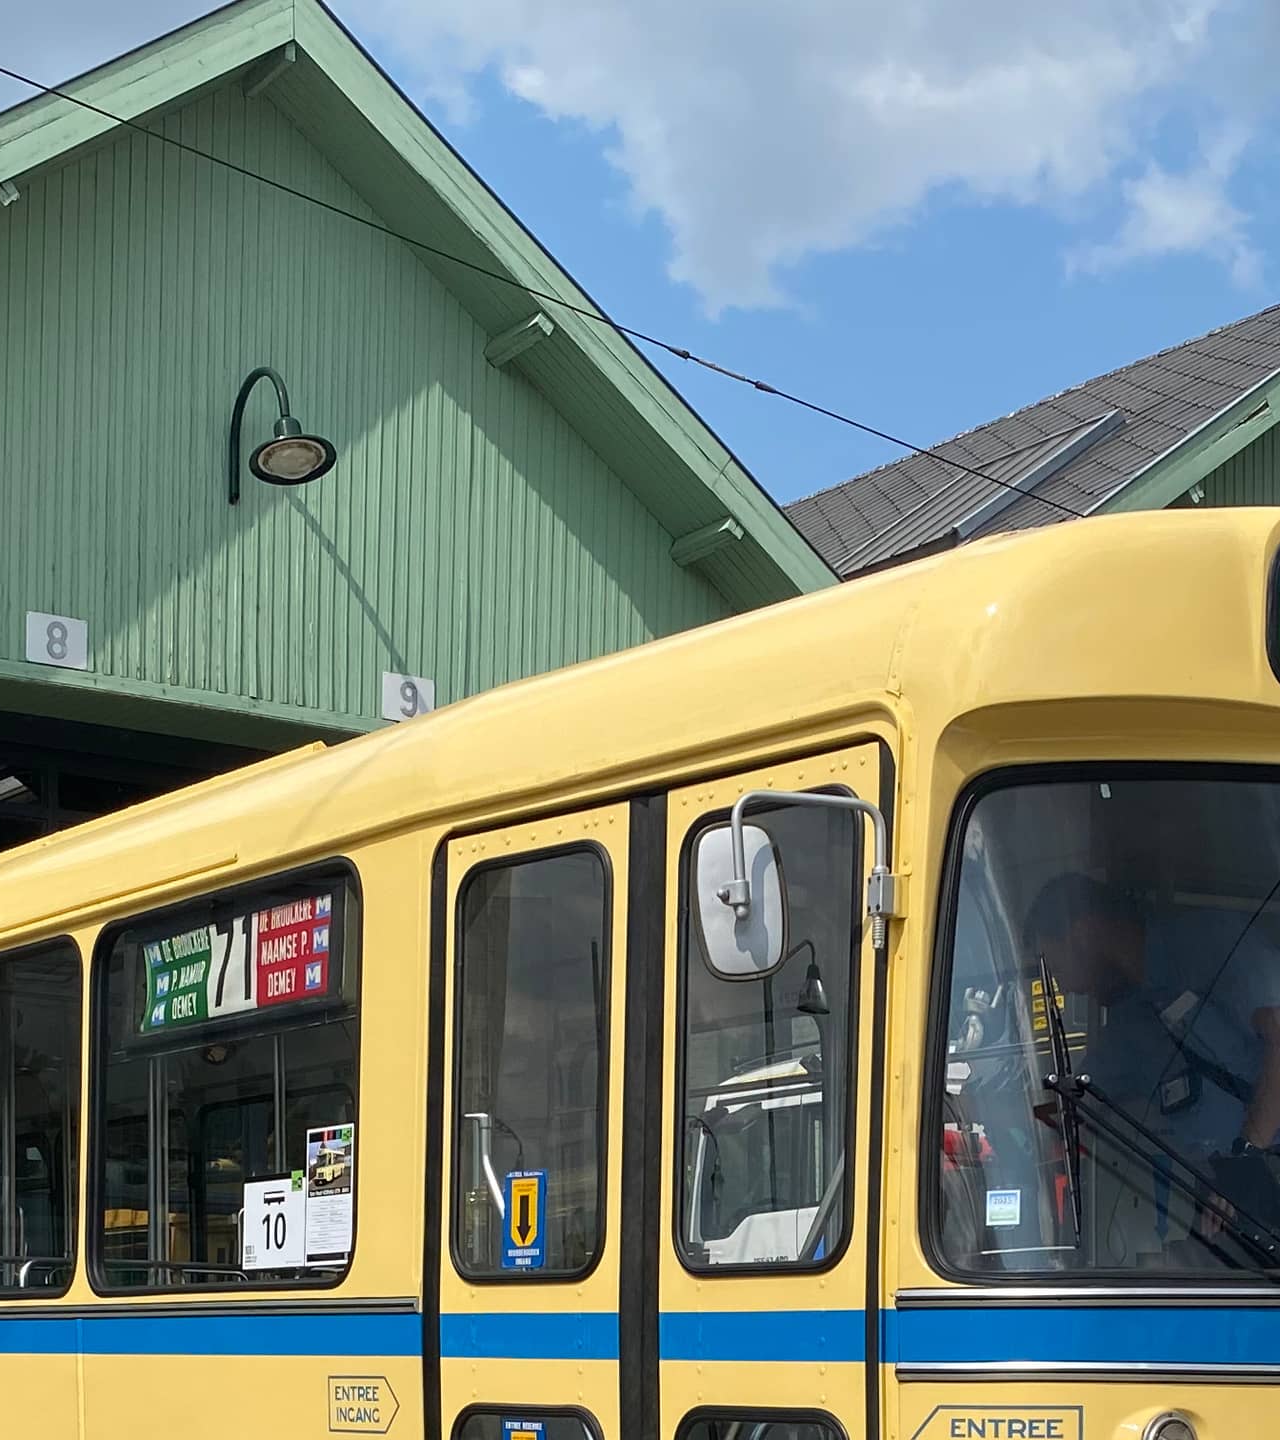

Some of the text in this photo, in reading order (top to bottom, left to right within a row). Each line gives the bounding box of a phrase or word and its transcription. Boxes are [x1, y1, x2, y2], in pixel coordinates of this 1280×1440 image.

[46, 620, 69, 660] 8
[398, 679, 419, 718] 9
[215, 915, 252, 1008] 71
[260, 931, 298, 967] NAAMSE
[300, 930, 310, 956] P.
[171, 968, 179, 992] P.
[178, 960, 207, 989] NAMUR
[267, 967, 297, 998] DEMEY
[171, 991, 198, 1020] DEMEY
[261, 1212, 287, 1251] 10
[334, 1386, 380, 1402] ENTREE
[336, 1407, 380, 1423] INGANG
[950, 1417, 1064, 1439] ENTREE
